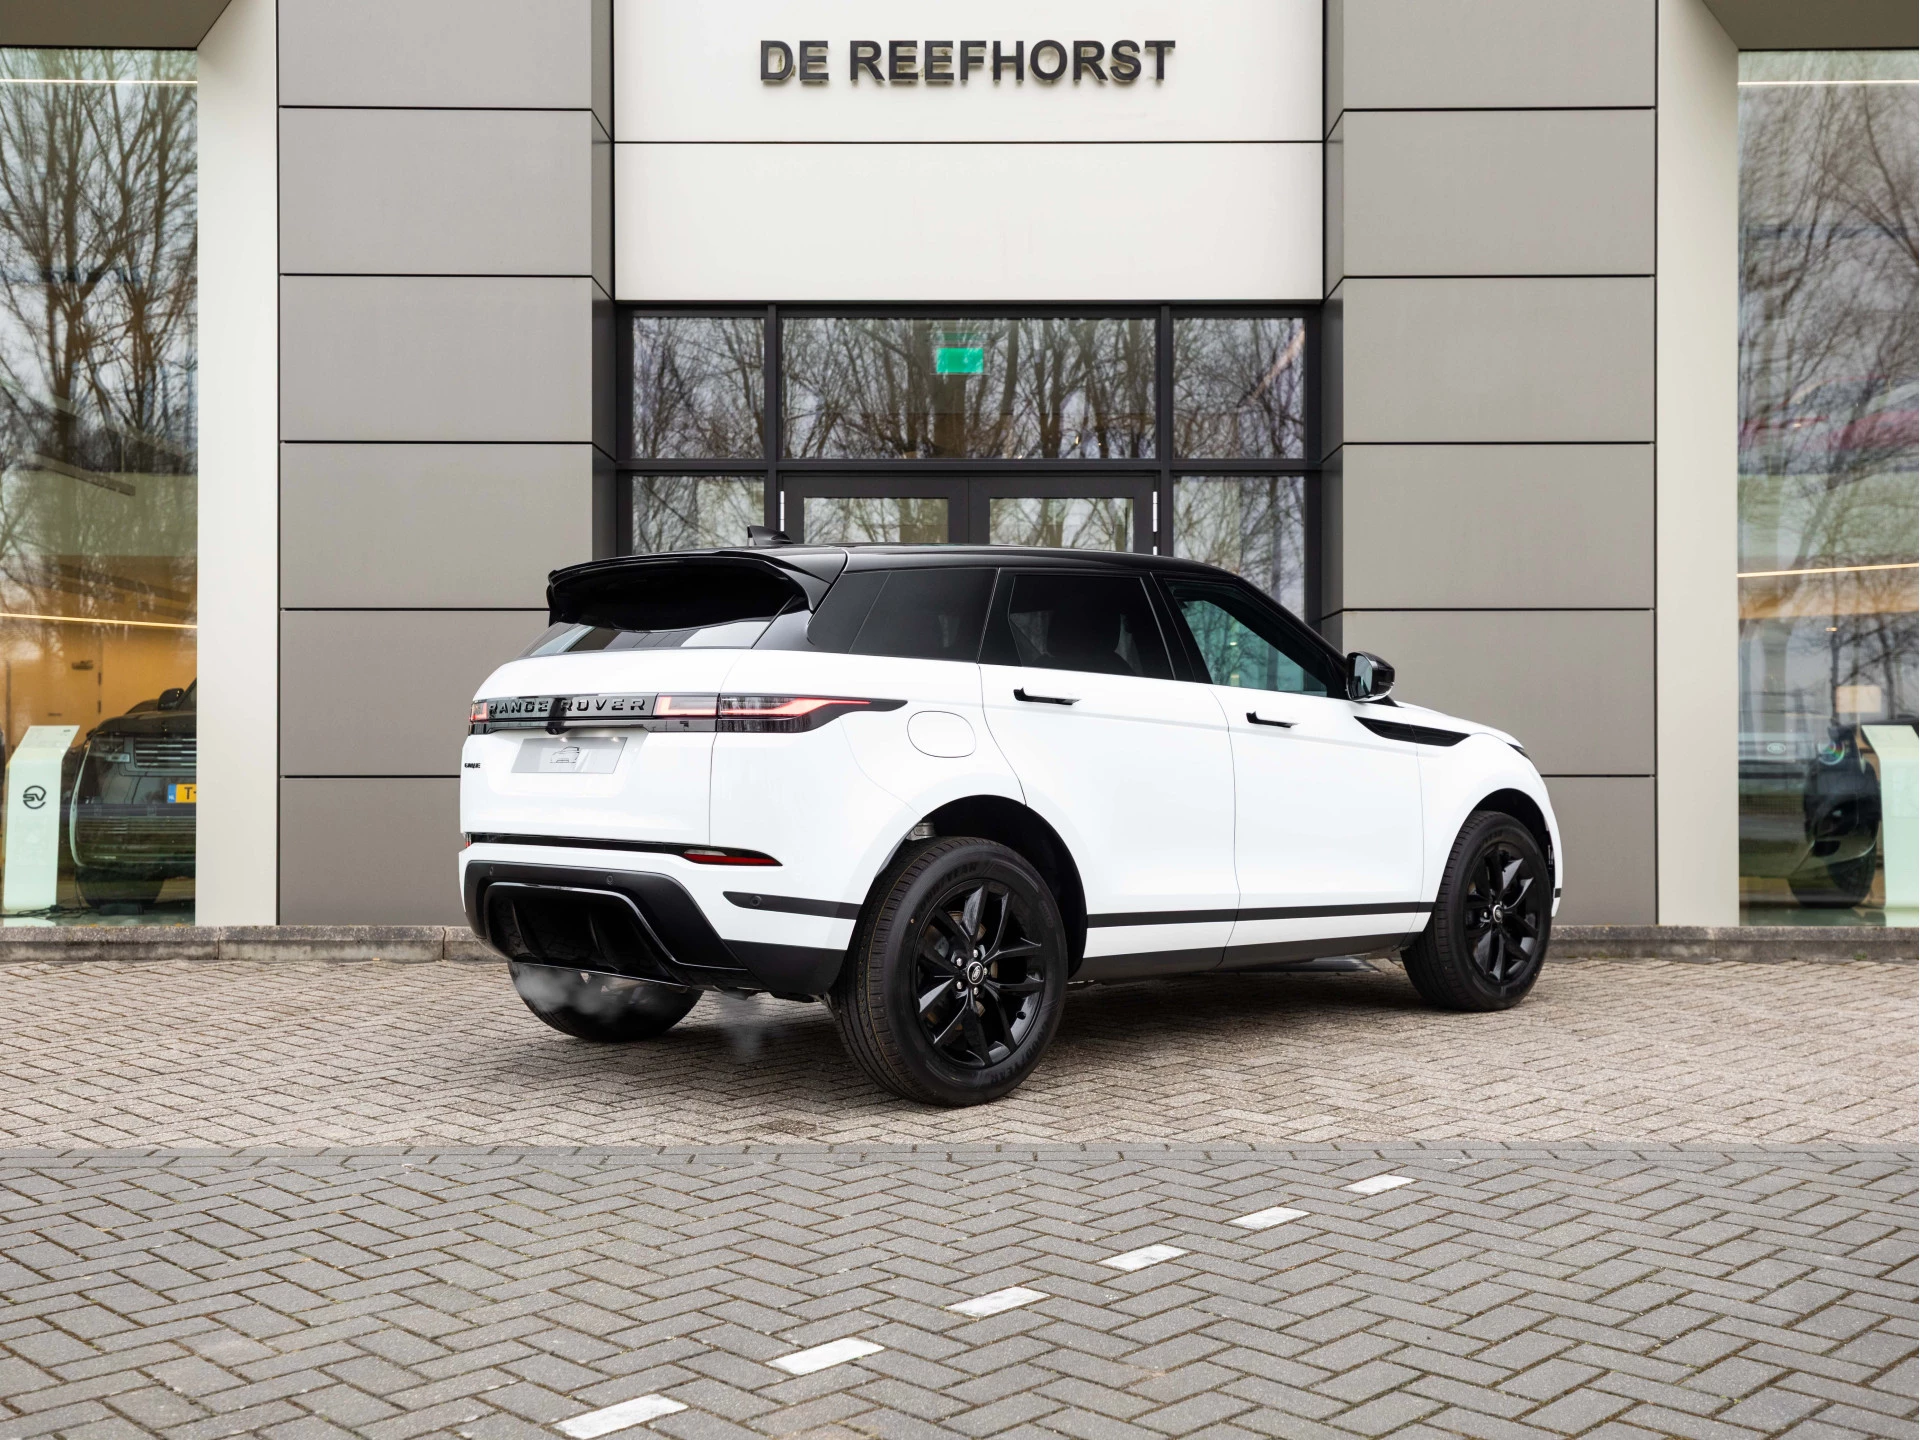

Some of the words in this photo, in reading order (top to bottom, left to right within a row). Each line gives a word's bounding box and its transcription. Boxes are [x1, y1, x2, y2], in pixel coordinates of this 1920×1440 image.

[761, 40, 829, 82] DE
[850, 40, 1176, 82] REEFHORST
[488, 701, 549, 714] RANGE
[560, 698, 645, 712] ROVER
